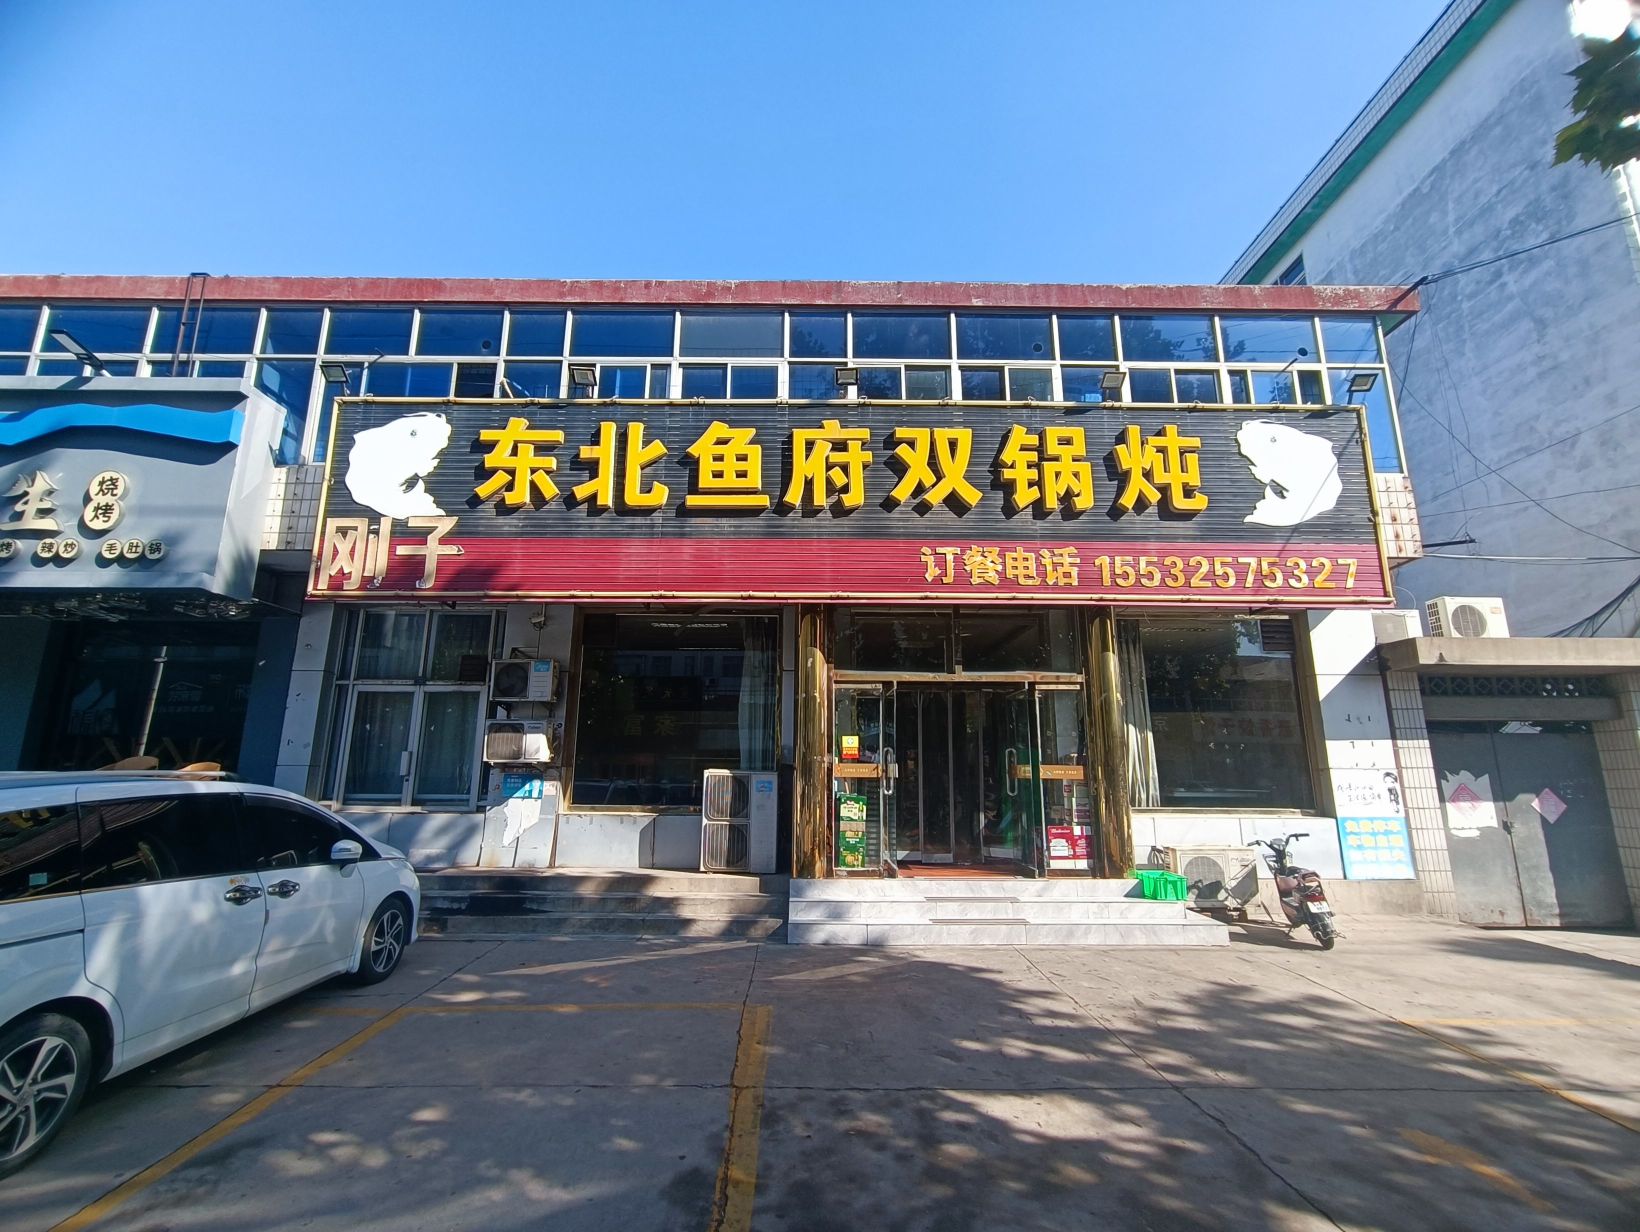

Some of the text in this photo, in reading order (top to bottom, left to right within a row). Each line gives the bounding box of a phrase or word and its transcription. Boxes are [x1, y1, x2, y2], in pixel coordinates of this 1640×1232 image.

[474, 417, 1208, 513] 东北鱼府双锅炖
[89, 476, 120, 523] 烧烤
[39, 541, 79, 555] 辣炒
[104, 542, 163, 555] 毛肚锅
[317, 517, 464, 590] 刚子
[920, 545, 1358, 590] 订餐电话 15532575327
